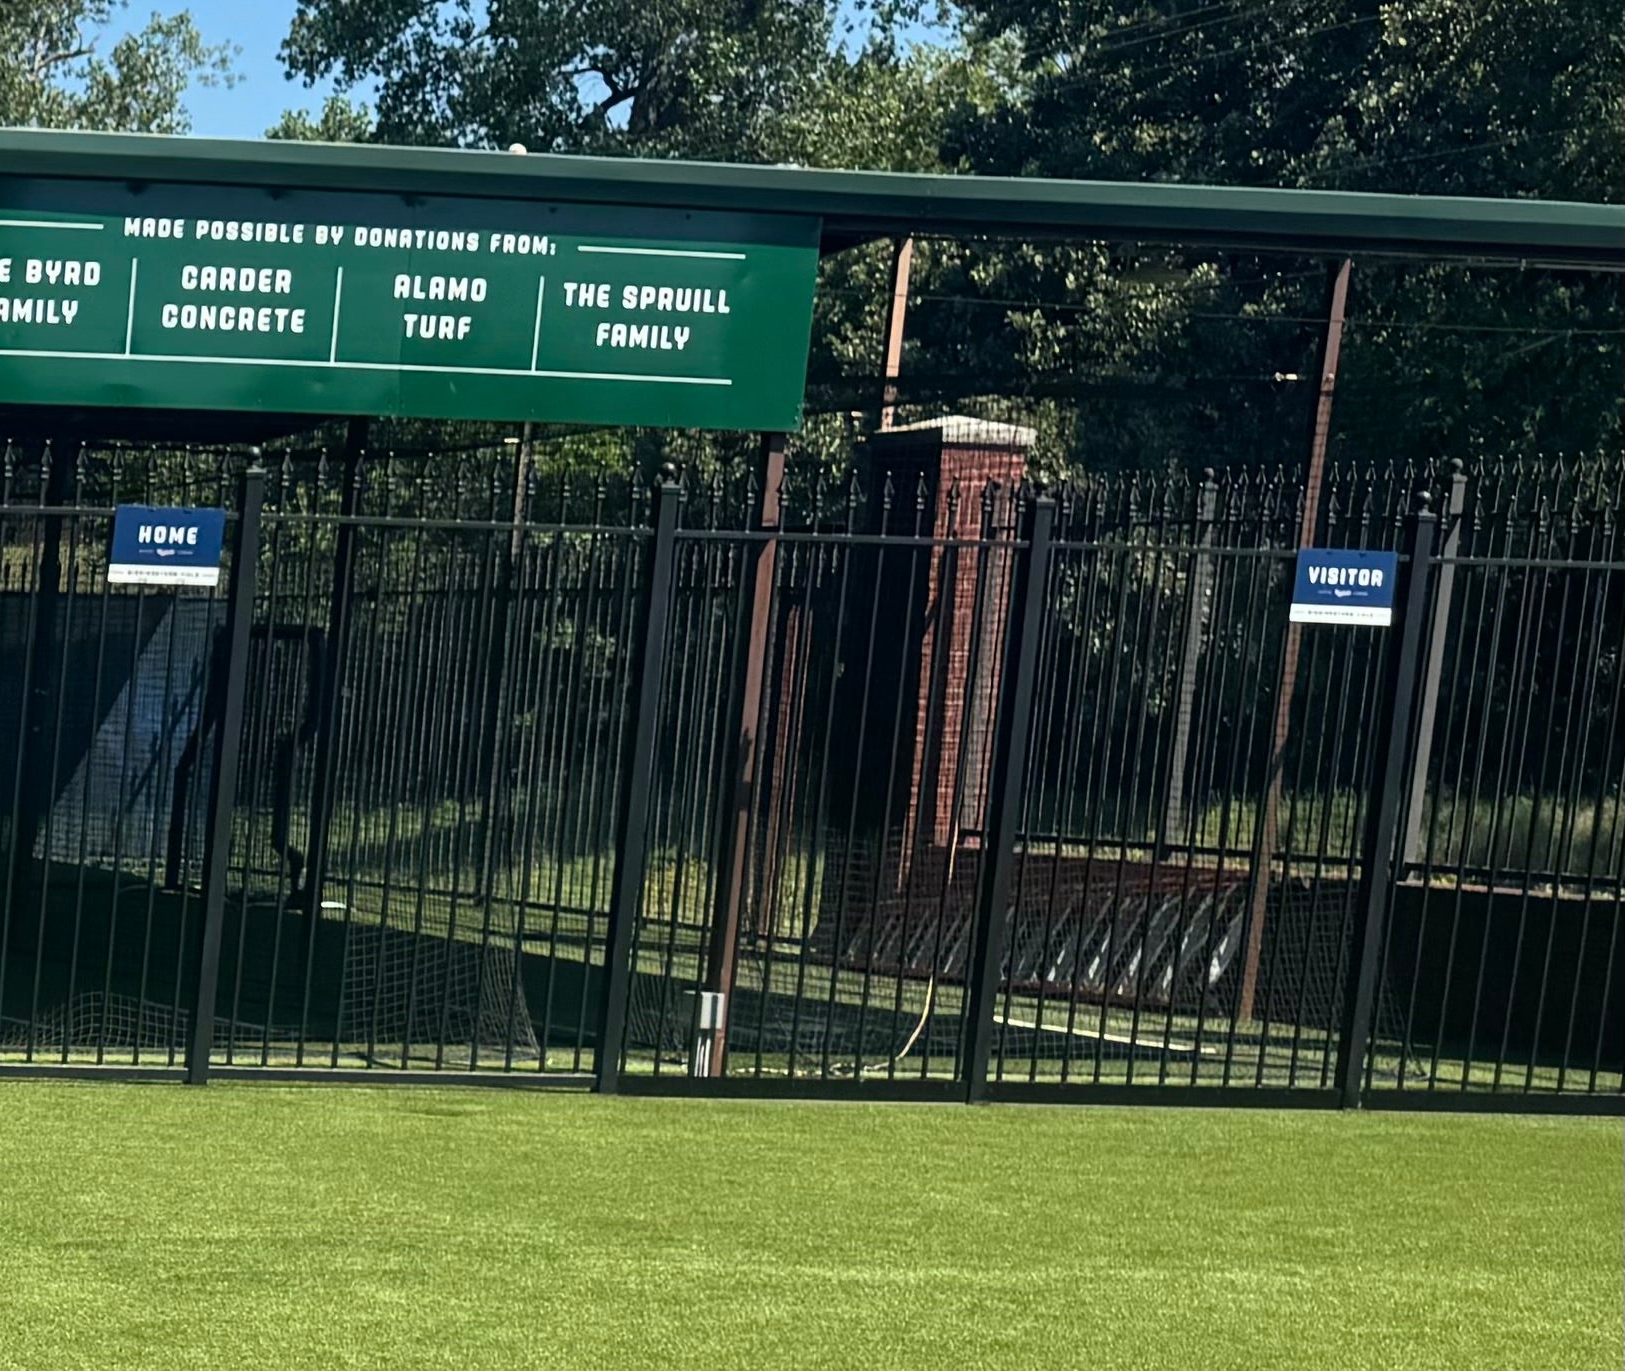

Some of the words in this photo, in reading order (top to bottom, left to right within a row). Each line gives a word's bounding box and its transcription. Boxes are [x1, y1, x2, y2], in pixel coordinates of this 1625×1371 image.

[123, 217, 185, 239] MADE
[195, 219, 305, 243] POSSIBLE
[315, 225, 344, 246] BY
[354, 226, 480, 252] DONATIONS
[489, 233, 556, 256] FROM:
[25, 258, 101, 286] BYRD
[181, 265, 292, 294] CARDER
[393, 274, 488, 302] ALAMO
[563, 282, 611, 309] THE
[621, 285, 731, 314] SPRUILL
[161, 303, 306, 334] CONCRETE
[403, 313, 472, 340] TURF
[596, 322, 690, 351] FAMILY
[138, 525, 199, 545] HOME
[1308, 566, 1384, 588] VISITOR
